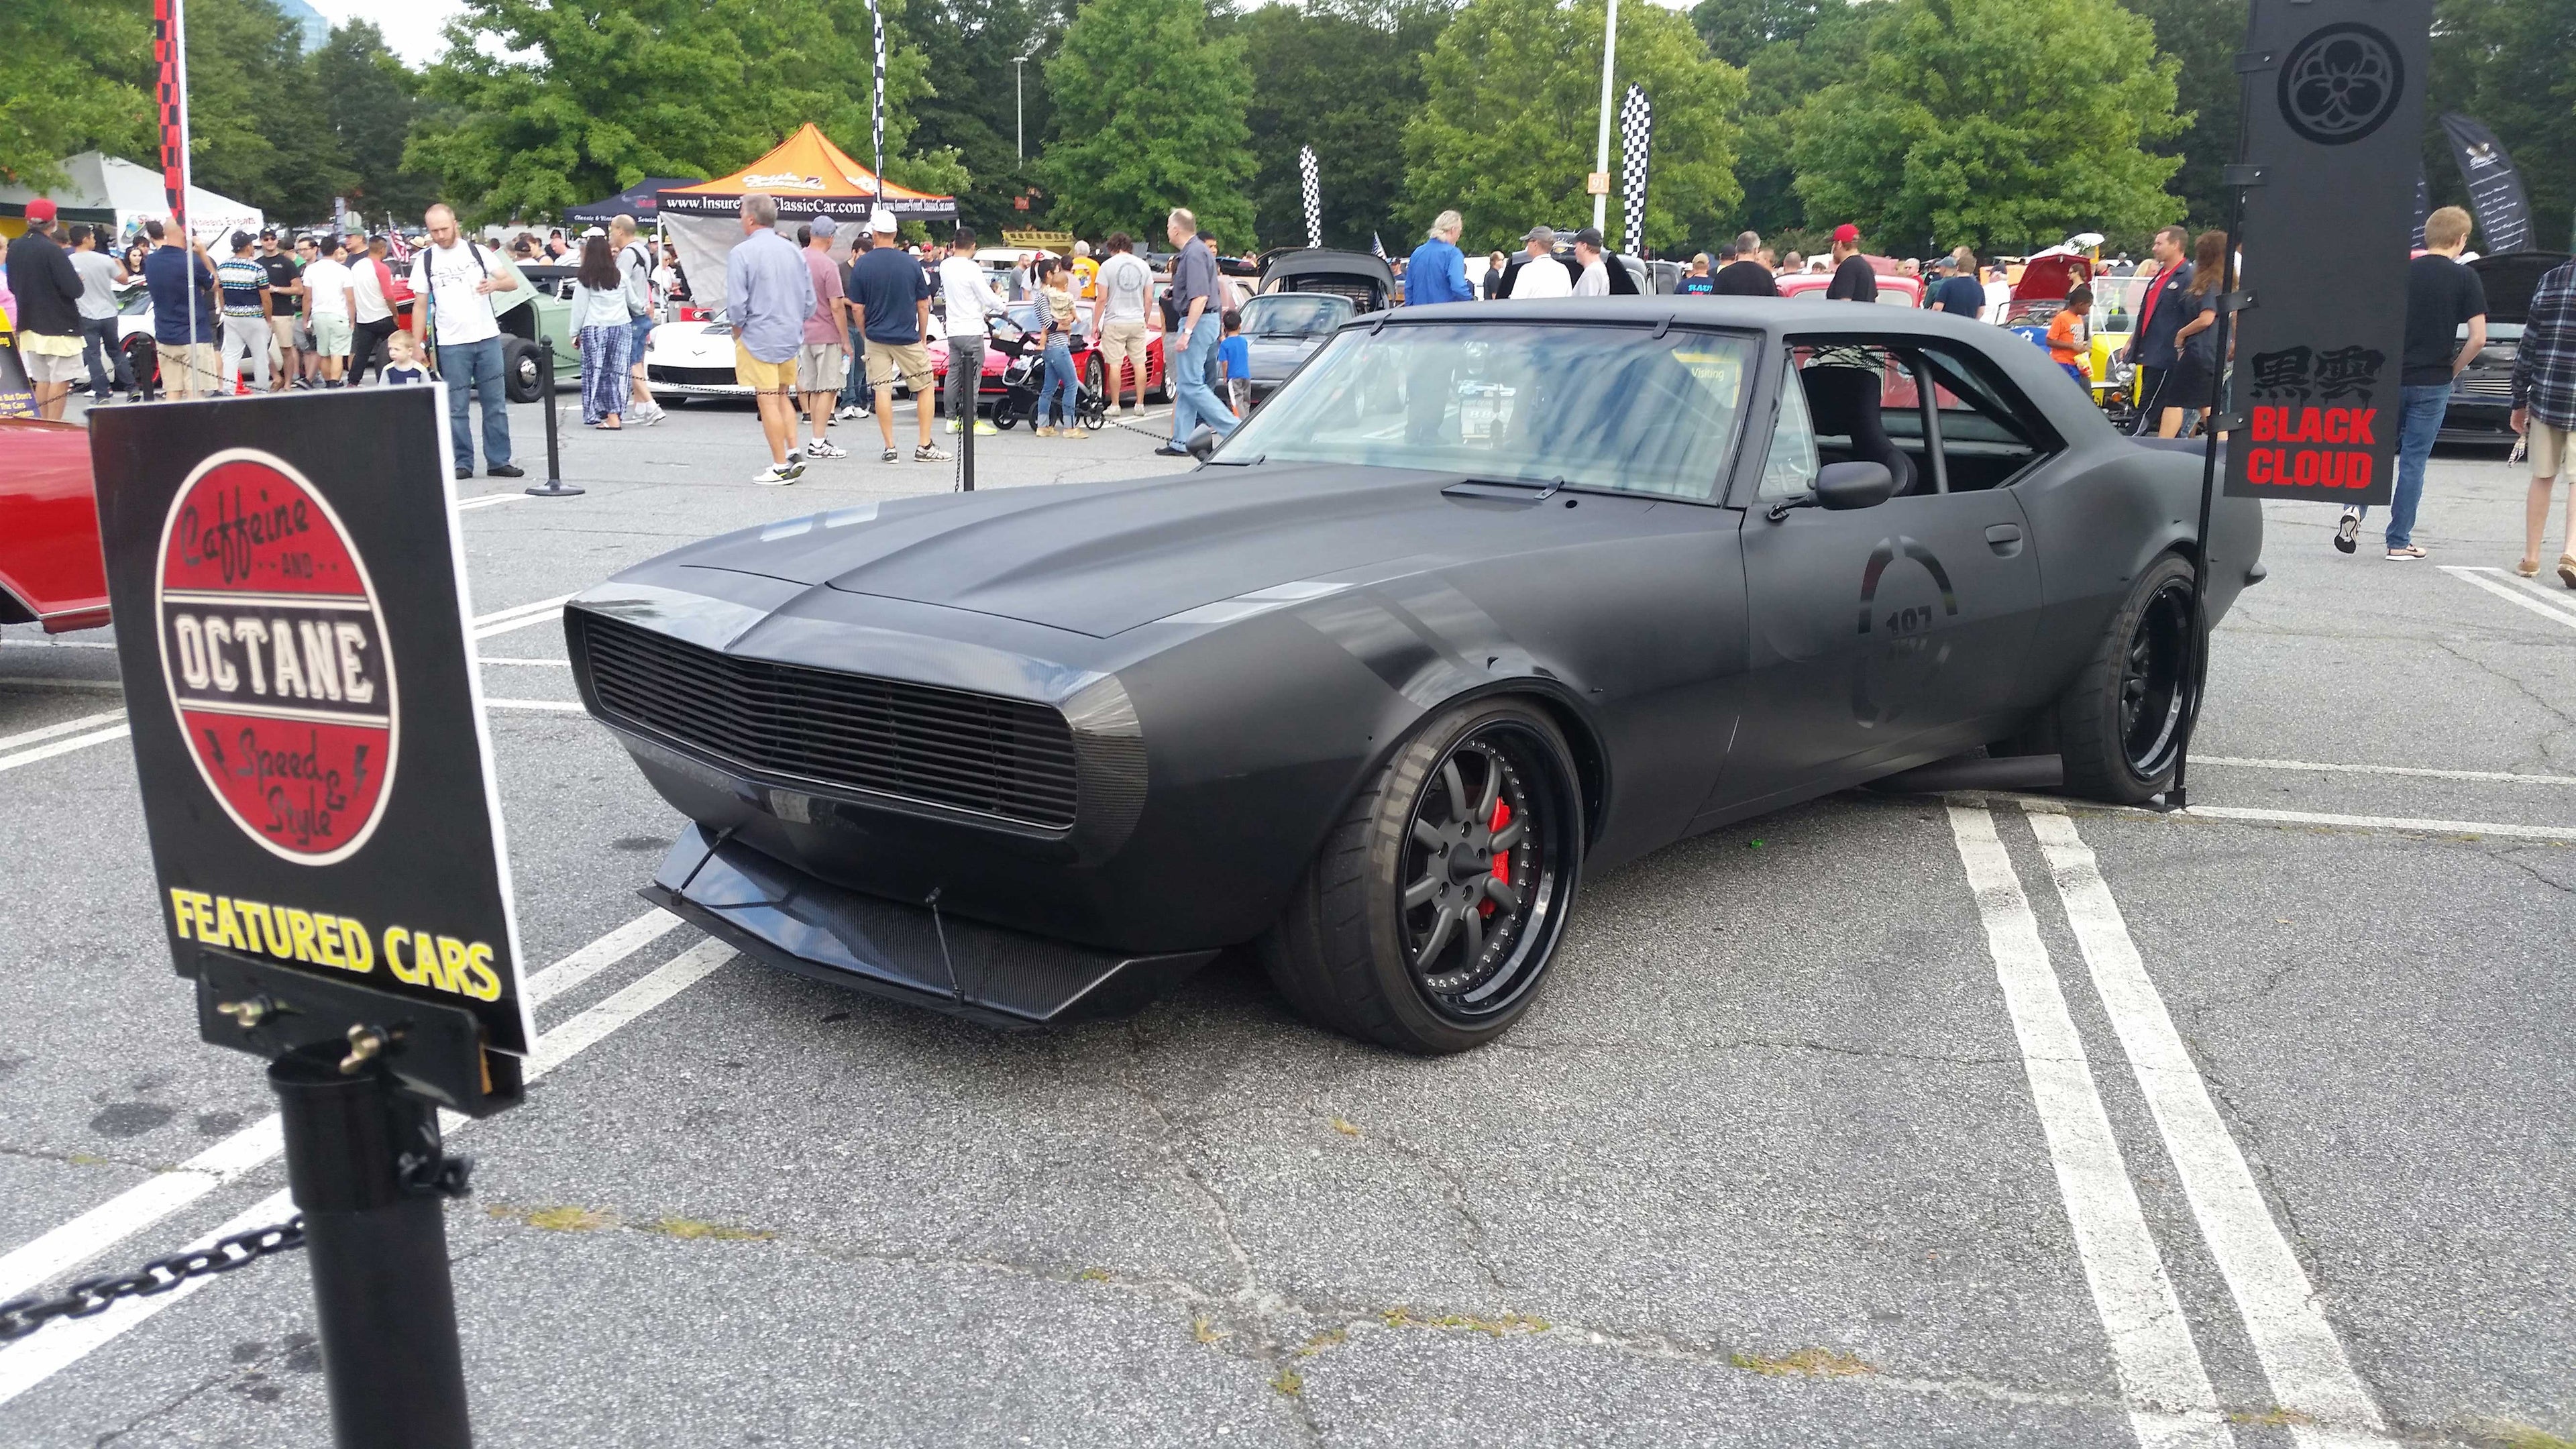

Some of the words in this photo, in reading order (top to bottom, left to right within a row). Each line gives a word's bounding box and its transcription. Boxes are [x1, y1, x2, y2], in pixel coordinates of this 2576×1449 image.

[1592, 177, 1605, 189] 91
[667, 196, 865, 213] www.InsureClassicCar.com
[1691, 367, 1725, 381] Visiting
[2251, 405, 2377, 445] BLACK
[2247, 447, 2373, 489] CLOUD
[180, 484, 309, 585] Caffeine
[282, 553, 313, 579] AND
[174, 613, 374, 704] OCTANE
[235, 727, 323, 796] Speed
[325, 769, 347, 812] &
[265, 784, 333, 847] Style
[170, 888, 374, 974] FEATURED
[383, 925, 502, 1002] CARS
